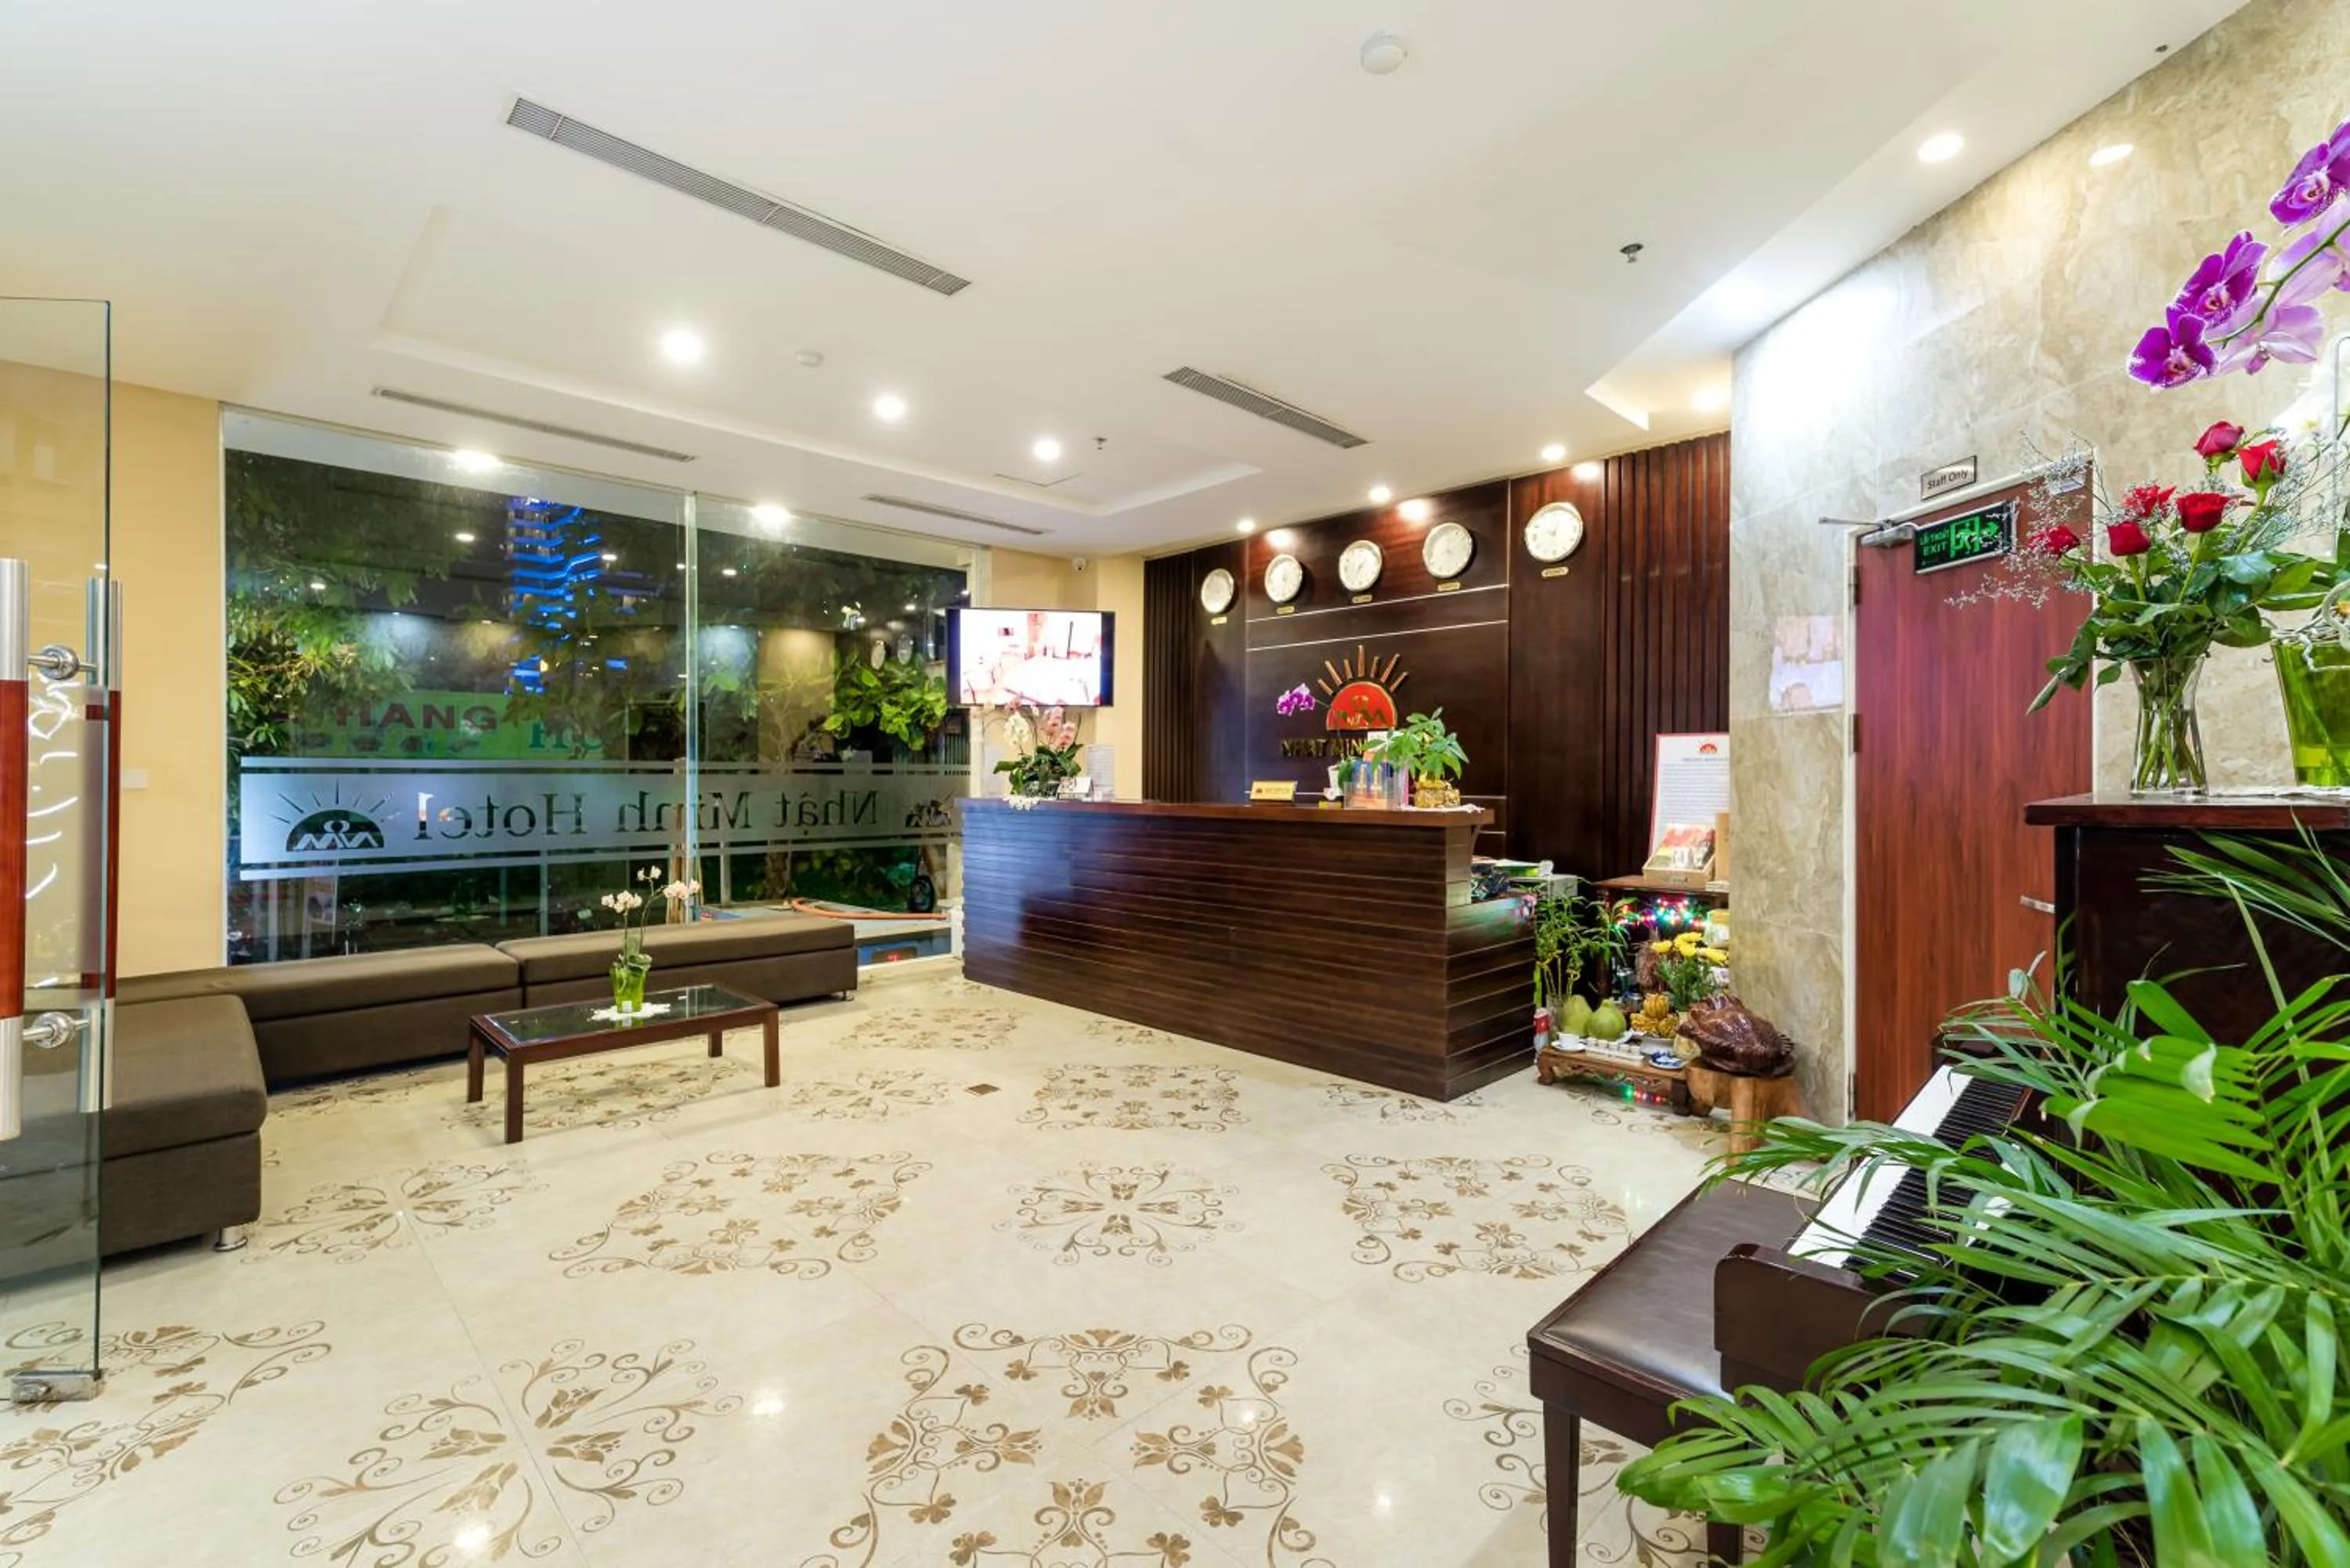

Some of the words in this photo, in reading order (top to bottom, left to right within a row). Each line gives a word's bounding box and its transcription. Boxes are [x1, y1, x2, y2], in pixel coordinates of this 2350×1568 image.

[1927, 475, 1947, 490] Staff
[1948, 469, 1969, 482] Only
[1923, 541, 1947, 555] EXIT
